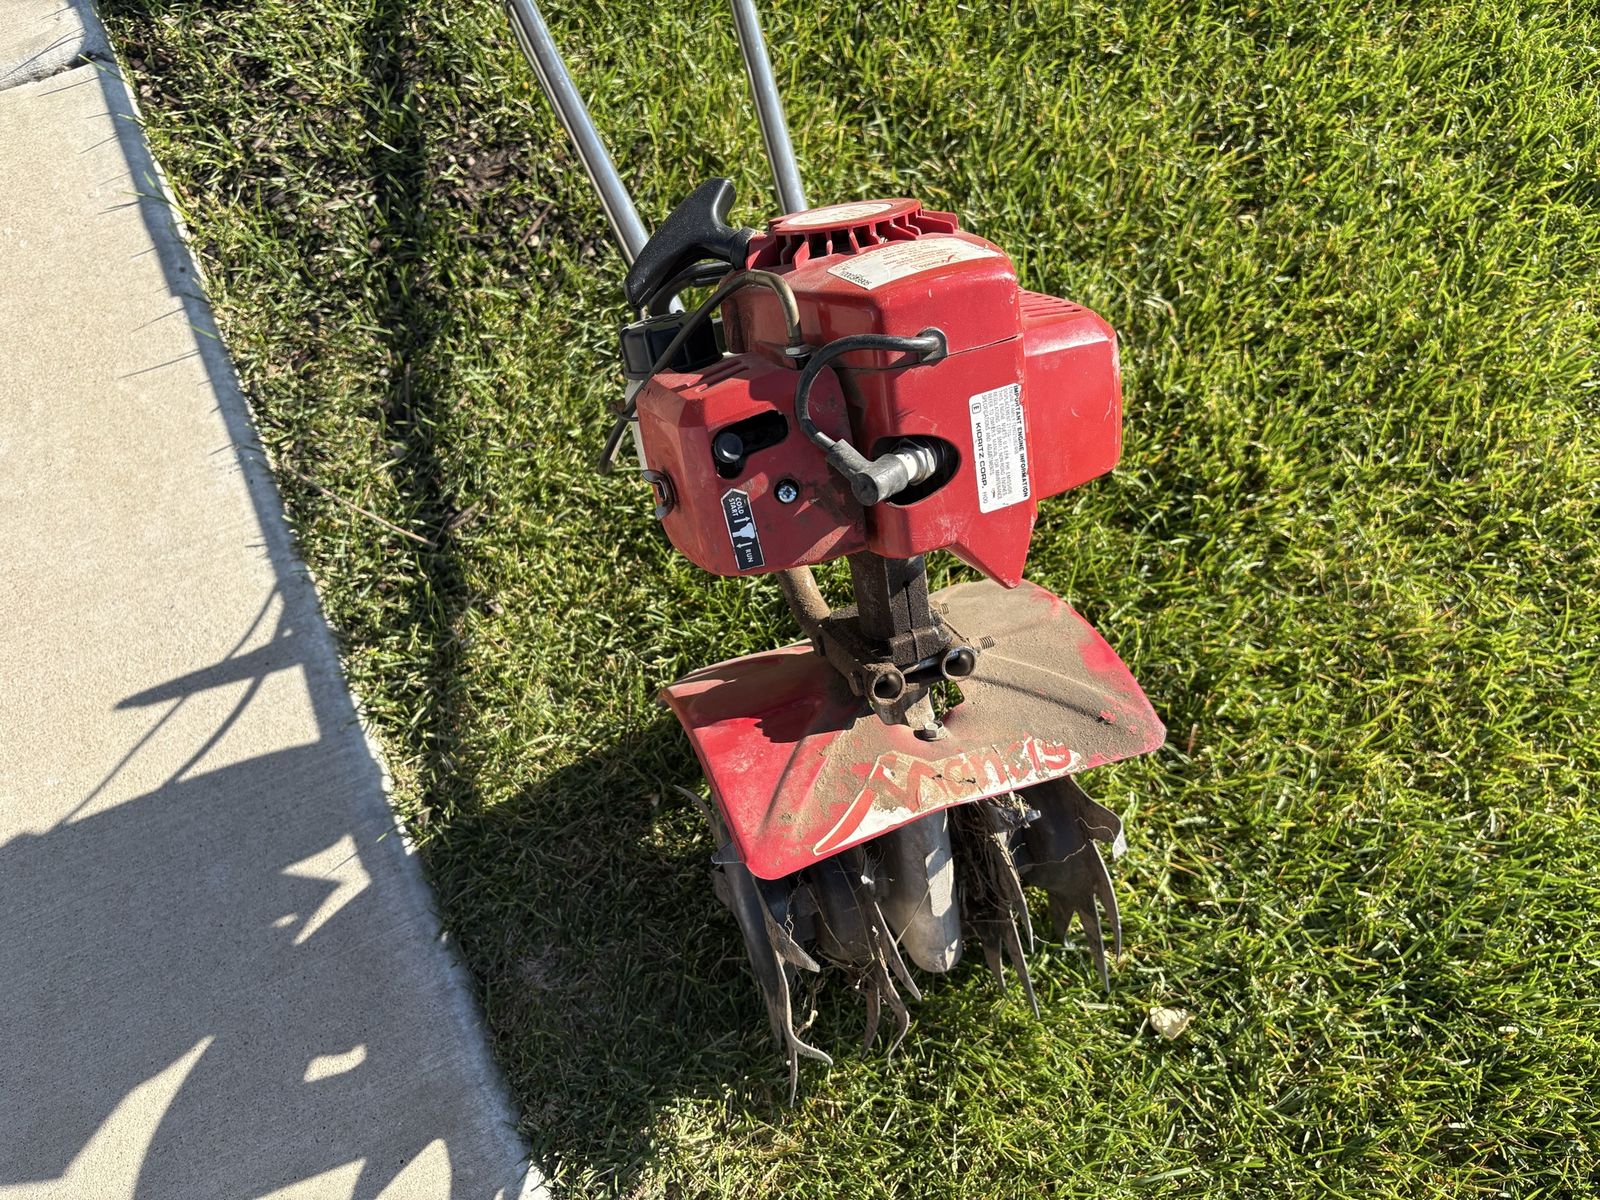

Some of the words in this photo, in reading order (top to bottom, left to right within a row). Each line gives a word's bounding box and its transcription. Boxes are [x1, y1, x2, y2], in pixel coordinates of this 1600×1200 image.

[981, 393, 990, 430] SPECIFICATIONS
[975, 421, 984, 459] KIORITZ
[1013, 385, 1021, 424] IMPORTANT
[1019, 453, 1028, 497] INFORMATION
[979, 460, 987, 488] CORP.
[728, 498, 738, 517] START
[735, 497, 744, 514] COLD
[745, 548, 754, 563] RUN
